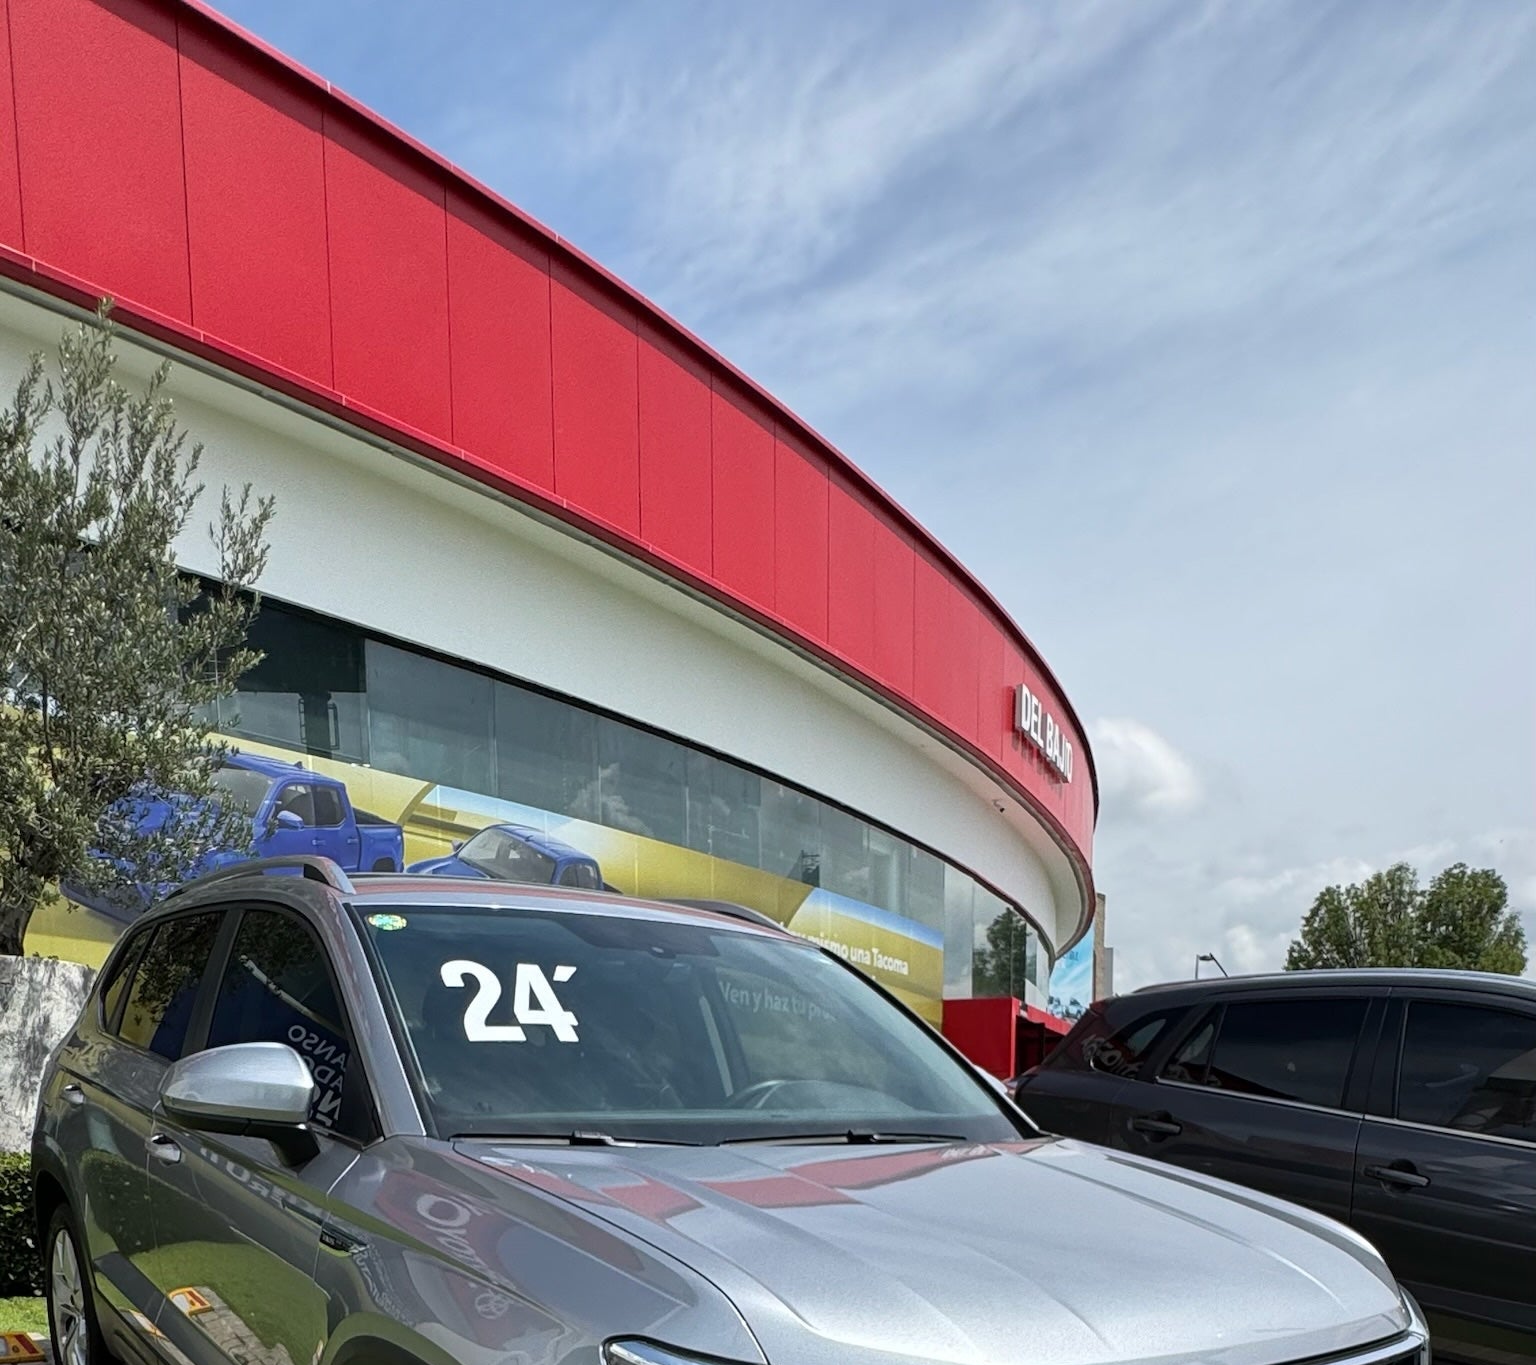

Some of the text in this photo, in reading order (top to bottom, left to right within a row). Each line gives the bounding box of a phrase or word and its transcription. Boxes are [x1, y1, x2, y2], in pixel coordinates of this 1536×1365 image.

[1018, 682, 1044, 749] DEL
[850, 947, 871, 966] una
[871, 947, 909, 976] Tacoma
[719, 980, 749, 1006] Ven
